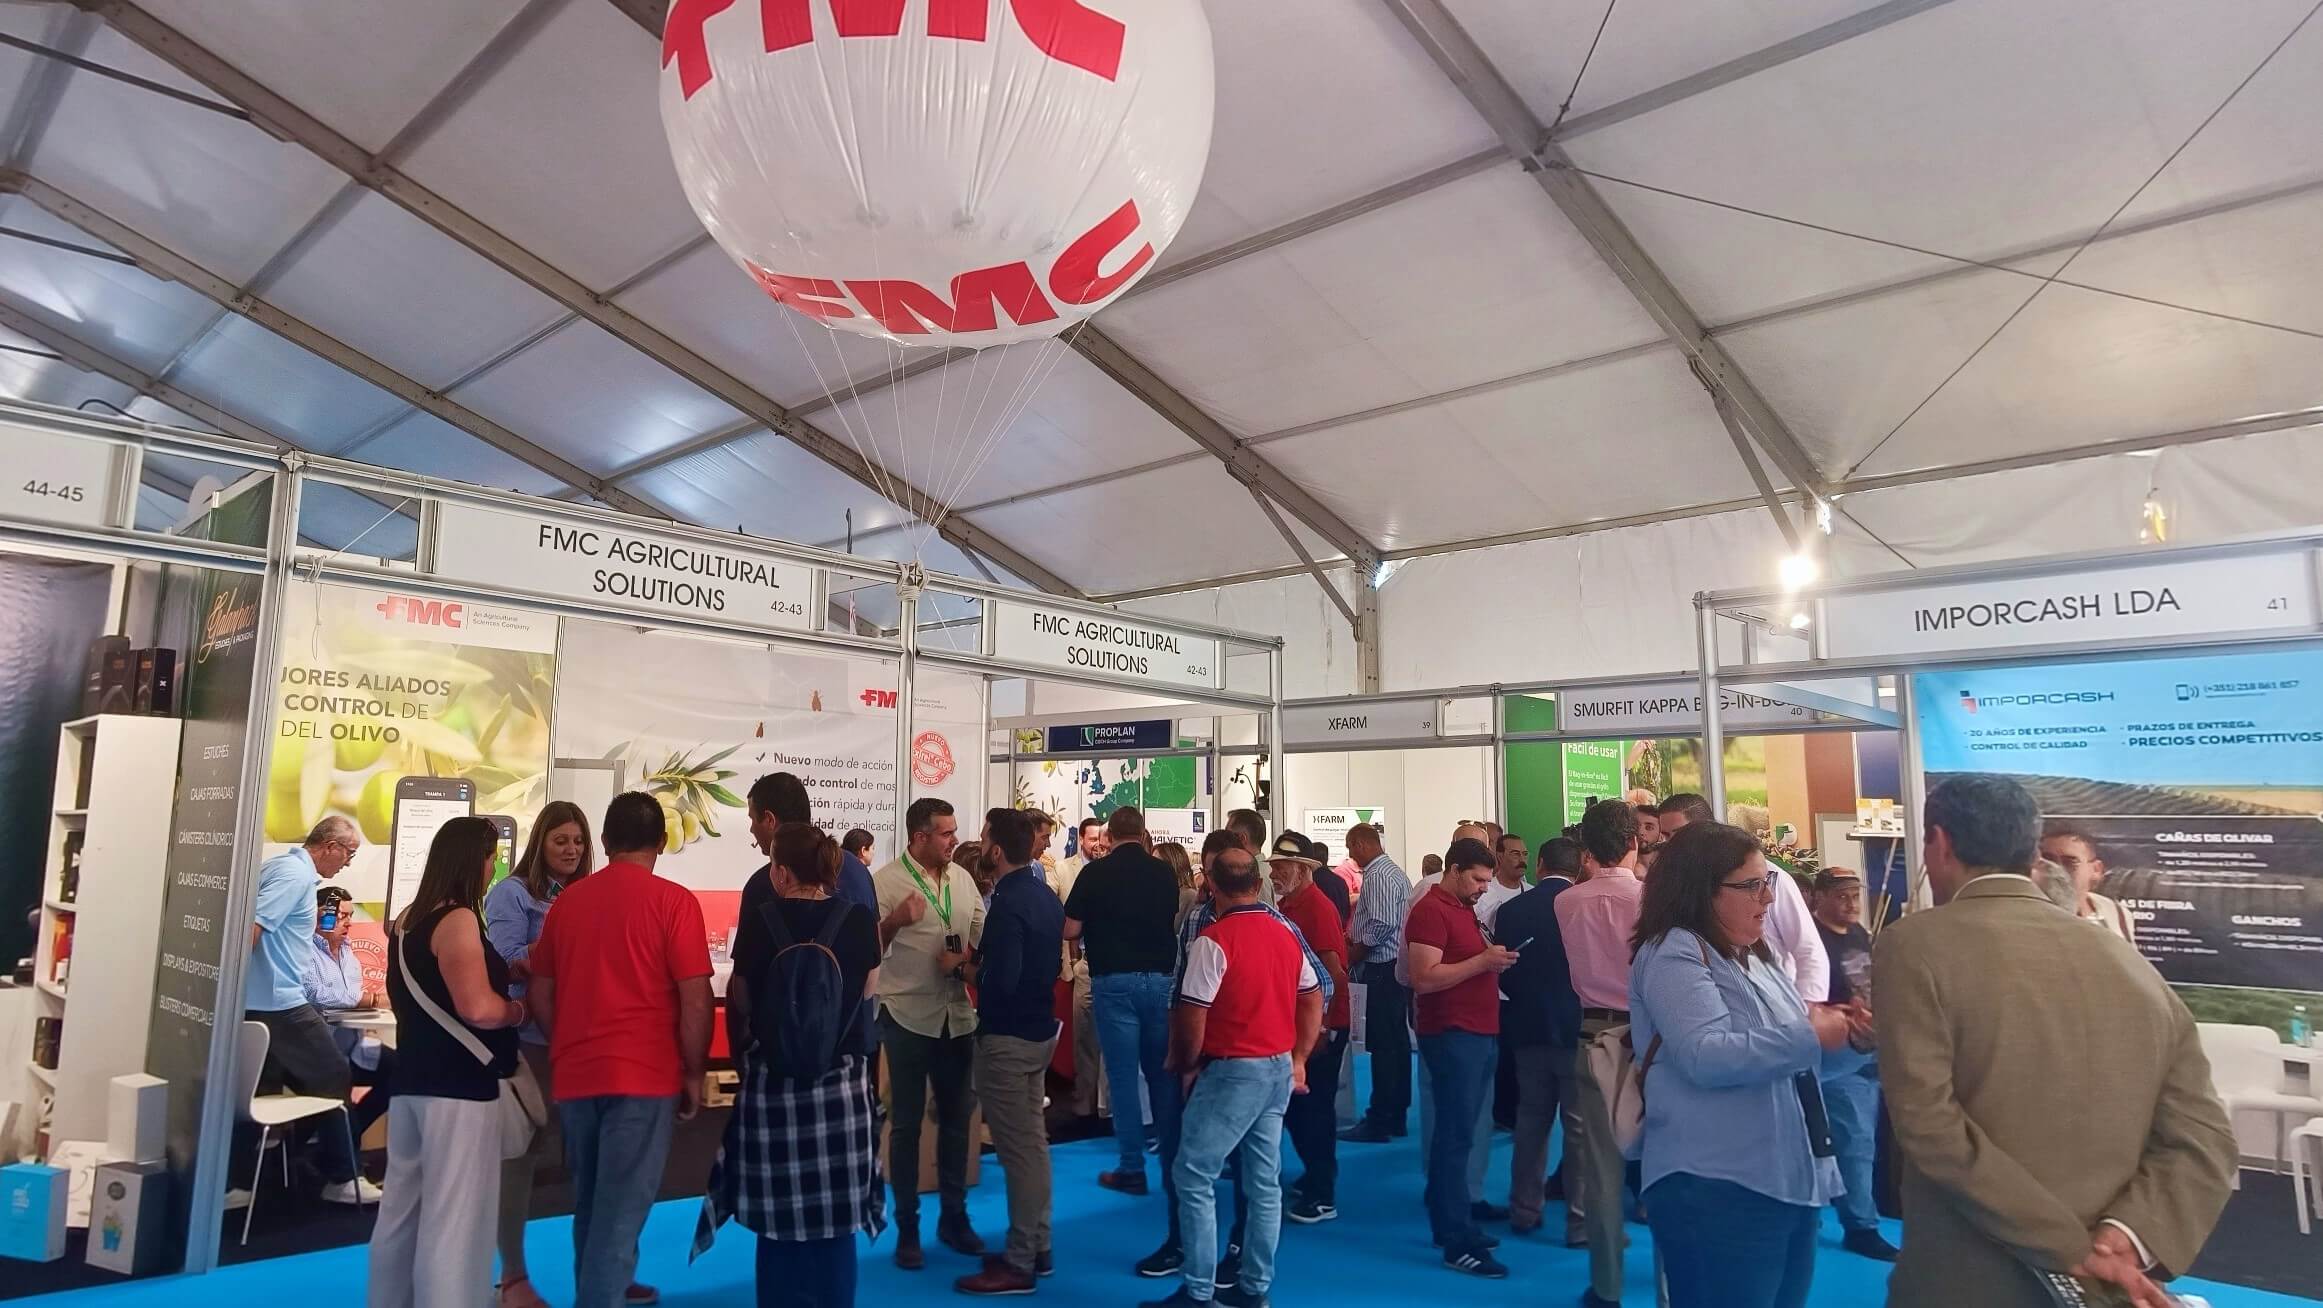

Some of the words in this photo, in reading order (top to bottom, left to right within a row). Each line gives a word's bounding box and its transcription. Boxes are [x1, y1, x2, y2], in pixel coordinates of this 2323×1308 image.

[743, 198, 1155, 335] FMC
[22, 480, 84, 501] 44-45
[539, 524, 600, 556] FMC
[608, 538, 780, 588] AGRICULTURAL
[593, 570, 726, 611] SOLUTIONS
[770, 600, 803, 616] 42-43
[376, 593, 463, 628] FMC
[1914, 594, 2102, 632] IMPORCASH
[2113, 588, 2181, 616] LDA
[2267, 598, 2289, 611] 41
[1033, 613, 1070, 636] FMC
[1075, 621, 1181, 655] AGRICULTURAL
[1067, 646, 1148, 675] SOLUTIONS
[1187, 665, 1207, 676] 42-43
[281, 666, 349, 688] JORES
[356, 673, 450, 696] ALIADOS
[284, 694, 395, 718] CONTROL
[402, 702, 430, 720] DE
[860, 689, 897, 709] FM
[1574, 700, 1634, 717] SMURFIT
[1640, 697, 1689, 714] KAPPA
[1791, 707, 1803, 716] 40
[1979, 691, 2115, 707] IMPORCASH
[1328, 716, 1368, 730] XFARM
[1422, 721, 1431, 729] 39
[2018, 728, 2031, 736] DE
[2034, 726, 2107, 735] EXPERIENCIA
[2127, 723, 2175, 731] PRAZOS
[2178, 722, 2194, 730] DE
[2197, 721, 2255, 730] ENTREGA
[281, 720, 323, 739] DEL
[330, 723, 400, 743] OLIVO
[926, 733, 945, 746] NUEVO
[1095, 726, 1135, 737] PROPLAN
[2129, 736, 2195, 746] PRECIOS
[2198, 731, 2323, 745] COMPETITIVOS
[203, 743, 230, 759] ESTUCHES
[1589, 743, 1599, 756] de
[1600, 747, 1618, 759] usar
[1971, 742, 2020, 751] CONTROL
[2022, 742, 2037, 750] DE
[2039, 740, 2088, 749] CALIDAD
[774, 752, 811, 766] Nuevo
[814, 755, 844, 768] modo
[846, 757, 859, 769] de
[862, 760, 893, 770] acción
[820, 778, 858, 789] control
[860, 779, 873, 790] de
[876, 782, 896, 791] mos
[833, 798, 864, 812] rápida
[867, 802, 873, 813] y
[876, 800, 896, 811] dura
[837, 819, 850, 830] de
[853, 820, 896, 832] aplicació
[2155, 831, 2202, 842] CAÑAS
[2204, 833, 2222, 843] DE
[2223, 834, 2275, 843] OLIVAR
[2138, 900, 2155, 909] DE
[352, 941, 380, 954] NUEVO
